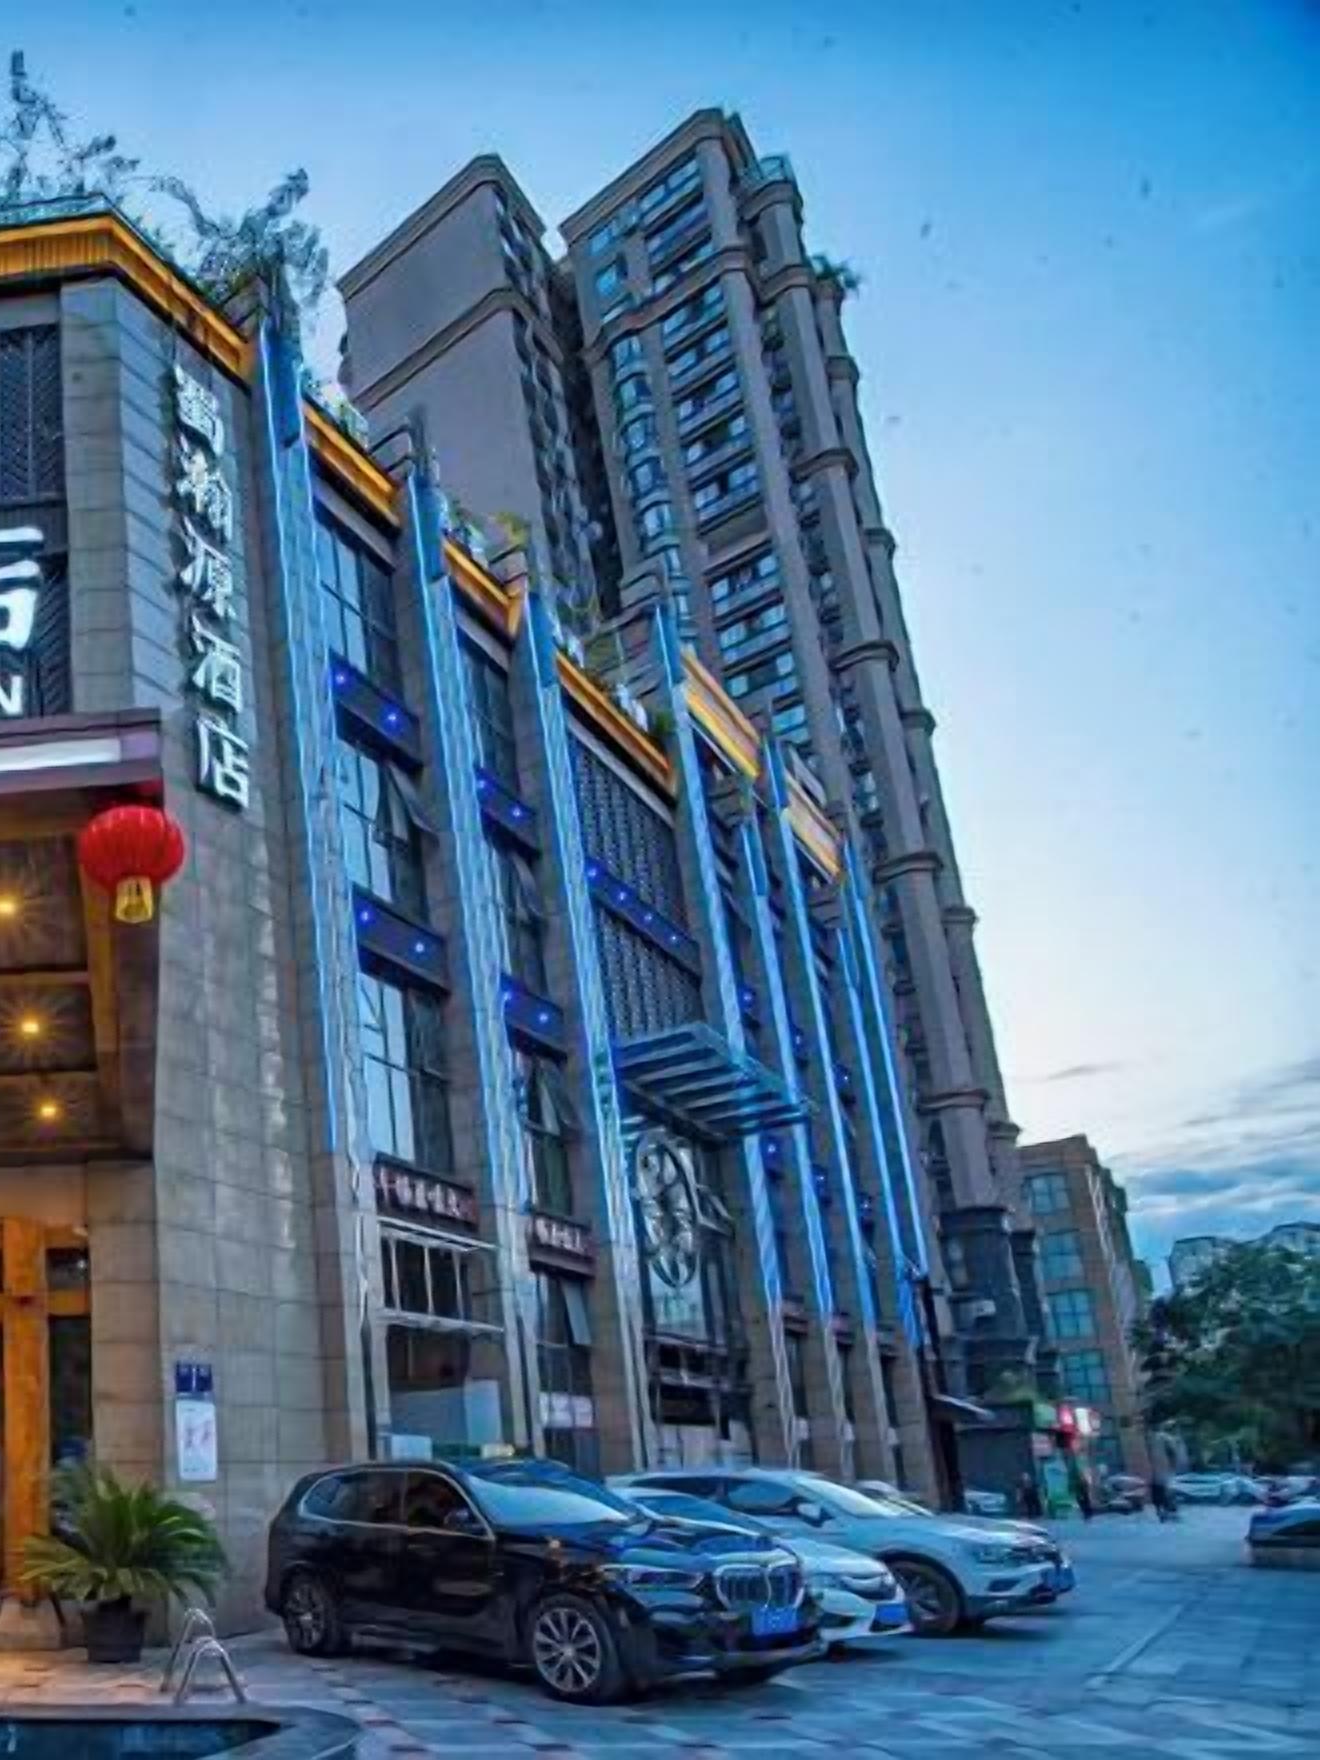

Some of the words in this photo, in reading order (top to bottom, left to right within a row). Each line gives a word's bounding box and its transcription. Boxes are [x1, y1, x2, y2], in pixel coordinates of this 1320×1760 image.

[174, 365, 249, 808] 蜀瀚源酒店
